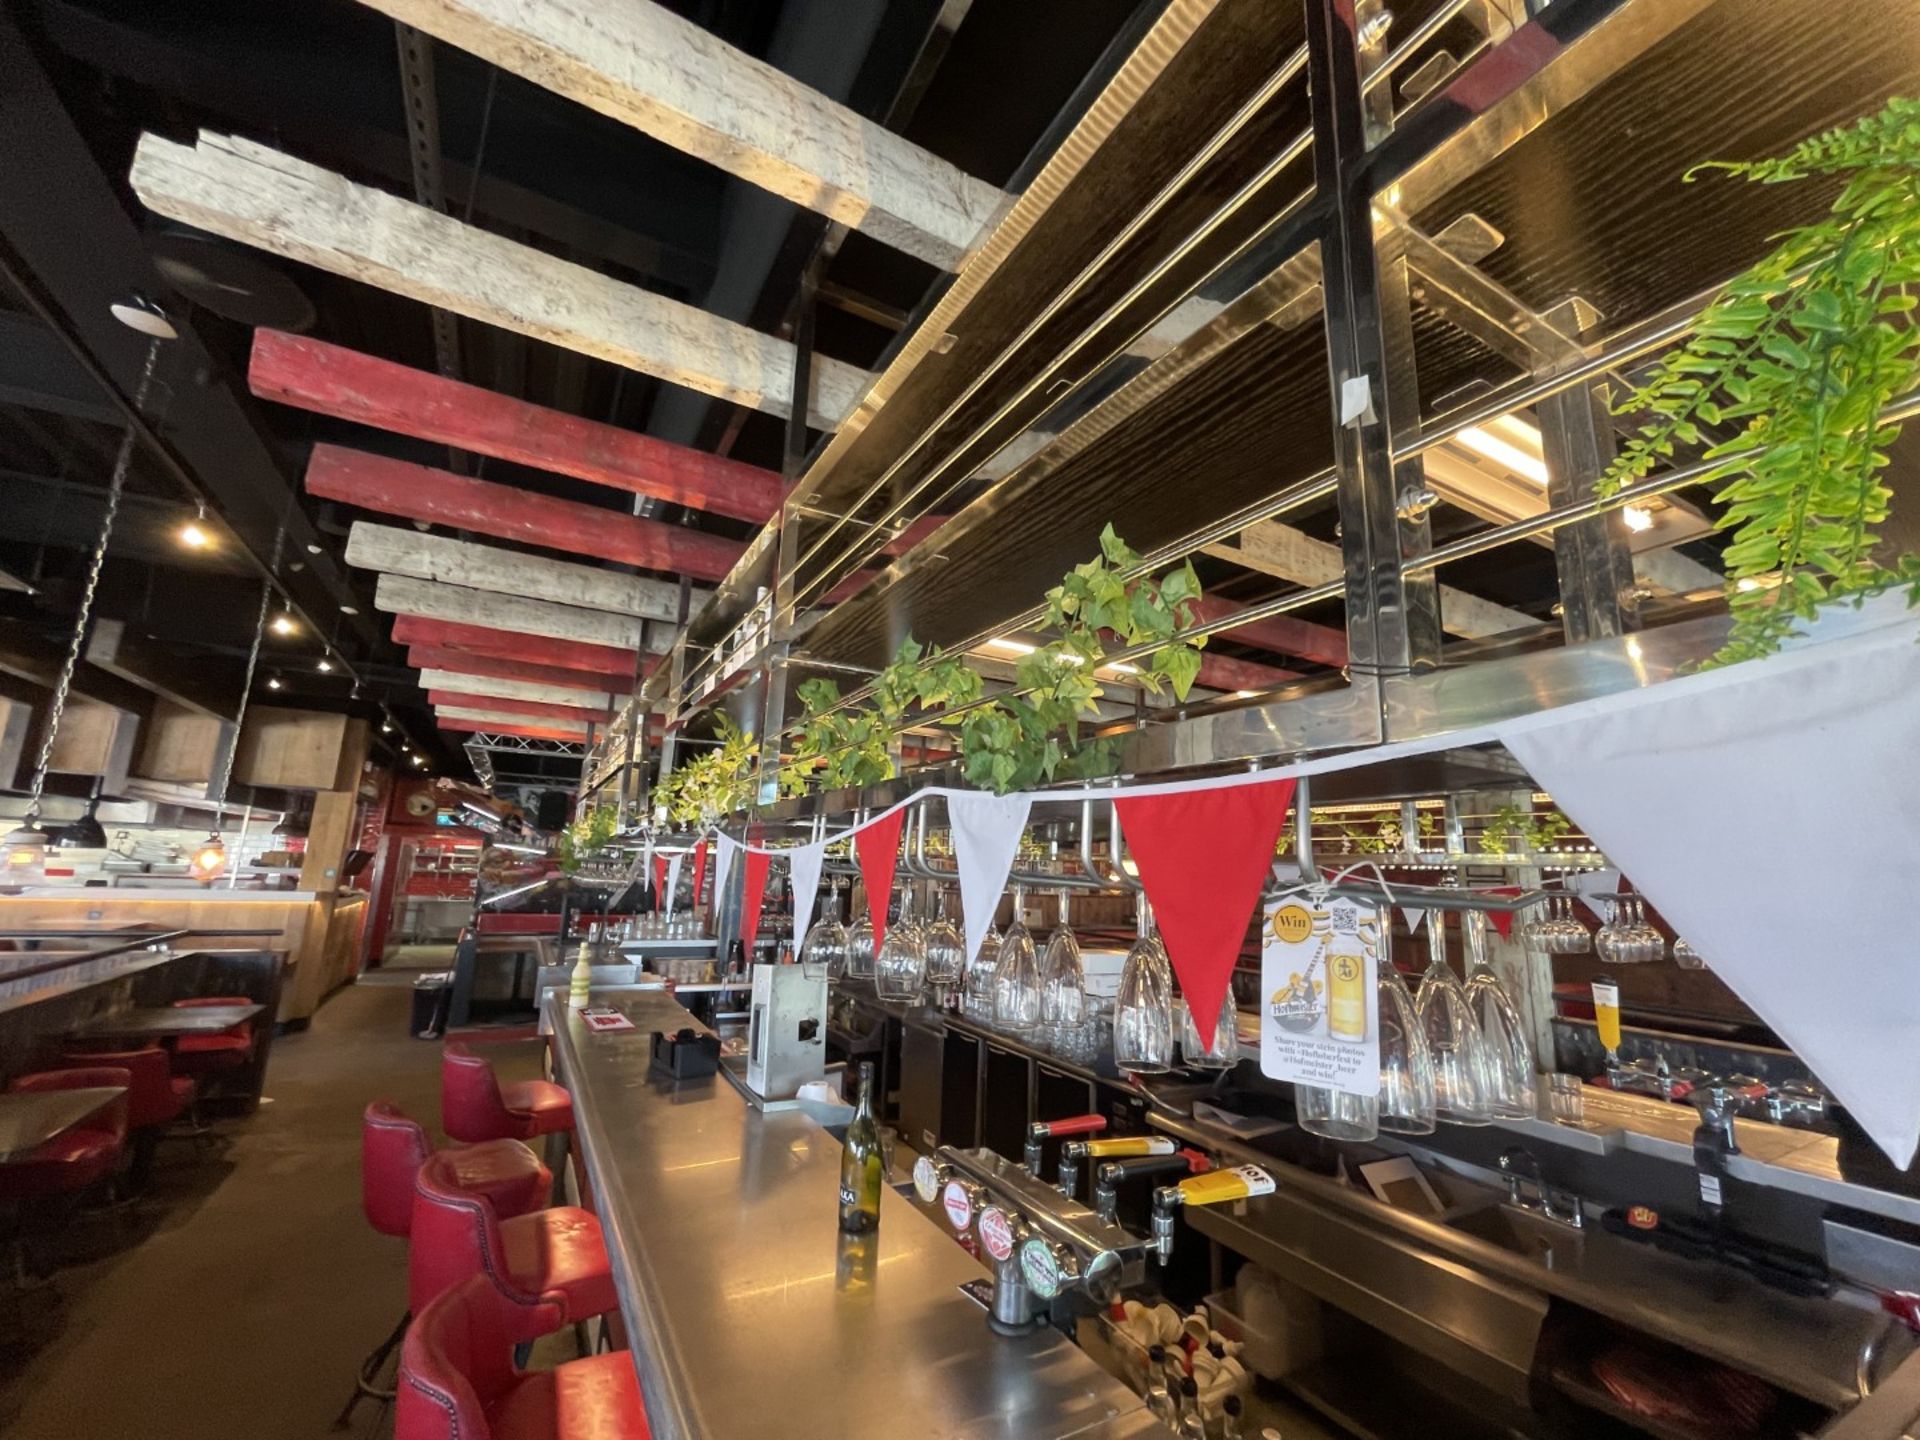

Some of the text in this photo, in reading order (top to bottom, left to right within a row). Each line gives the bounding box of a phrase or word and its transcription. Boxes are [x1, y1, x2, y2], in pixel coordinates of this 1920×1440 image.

[1280, 915, 1306, 928] Win
[1274, 1035, 1296, 1046] Share
[1297, 1040, 1314, 1049] your
[1337, 1044, 1365, 1057] photos
[1278, 1045, 1296, 1054] with
[1352, 1057, 1362, 1065] to
[1302, 1067, 1317, 1076] and
